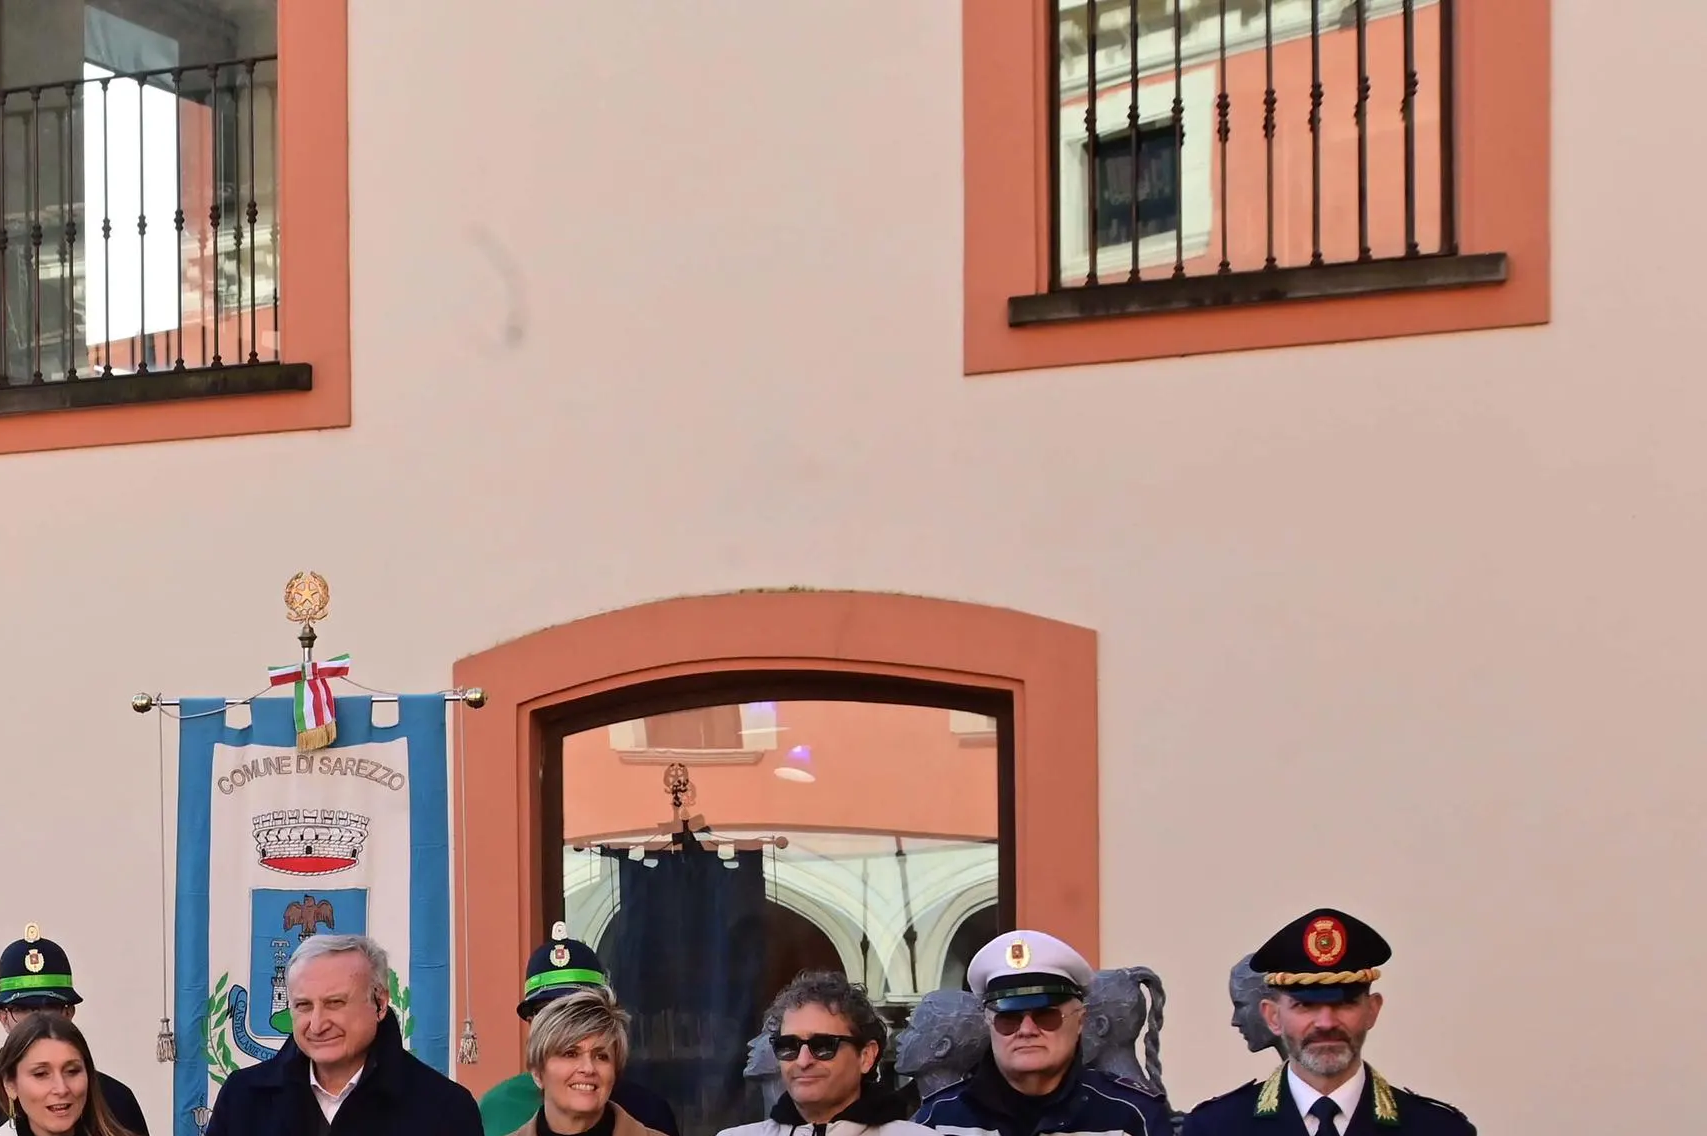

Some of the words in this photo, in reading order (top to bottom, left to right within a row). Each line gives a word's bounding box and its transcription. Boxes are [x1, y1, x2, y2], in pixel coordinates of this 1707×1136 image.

[217, 755, 292, 795] COMUNE
[295, 754, 314, 774] DI
[318, 756, 406, 791] SAREZZO
